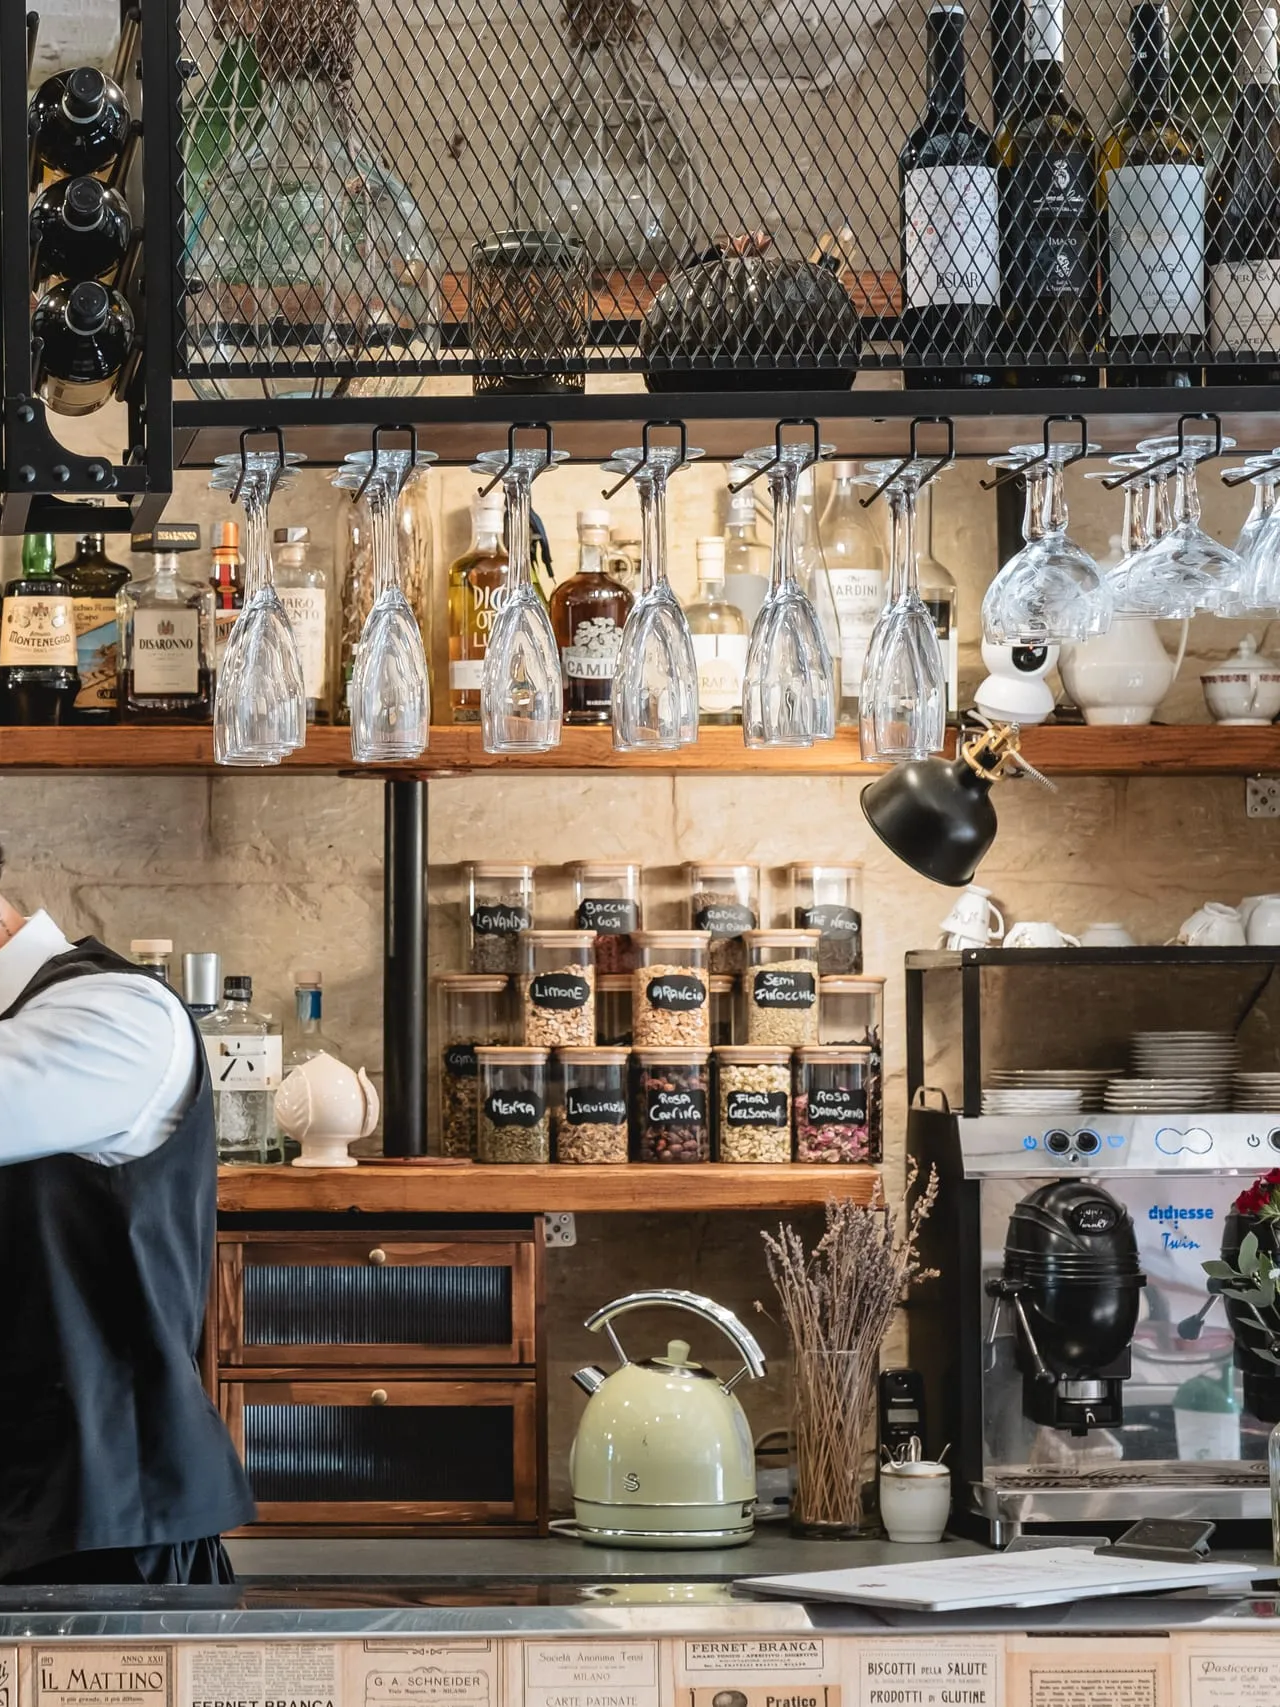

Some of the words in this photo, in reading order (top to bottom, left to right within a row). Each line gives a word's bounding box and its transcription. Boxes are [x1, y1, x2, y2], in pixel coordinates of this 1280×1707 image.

[8, 630, 71, 647] MONTENEGRO
[138, 638, 194, 650] DISARONNO
[476, 911, 529, 931] LAVANDA
[658, 1093, 692, 1105] ROSA
[816, 1091, 851, 1103] ROSA
[492, 1098, 536, 1117] MENTA
[1148, 1205, 1214, 1224] didiesse
[1161, 1232, 1201, 1253] Twin
[692, 1643, 748, 1653] FERNET
[759, 1641, 818, 1652] BRANCA
[121, 1655, 144, 1664] ANNO
[867, 1662, 916, 1676] BISCOTTI
[947, 1662, 988, 1676] SALUTE
[1201, 1660, 1269, 1675] Pasticceria
[66, 1668, 163, 1690] MATTINO
[408, 1676, 481, 1687] SCHNEIDER
[573, 1672, 610, 1681] MILANO
[546, 1695, 581, 1707] CARTE
[587, 1695, 638, 1707] PATINATE
[765, 1695, 817, 1707] Pratico
[870, 1690, 923, 1704] PRODOTTI
[942, 1690, 987, 1703] GLUTINE
